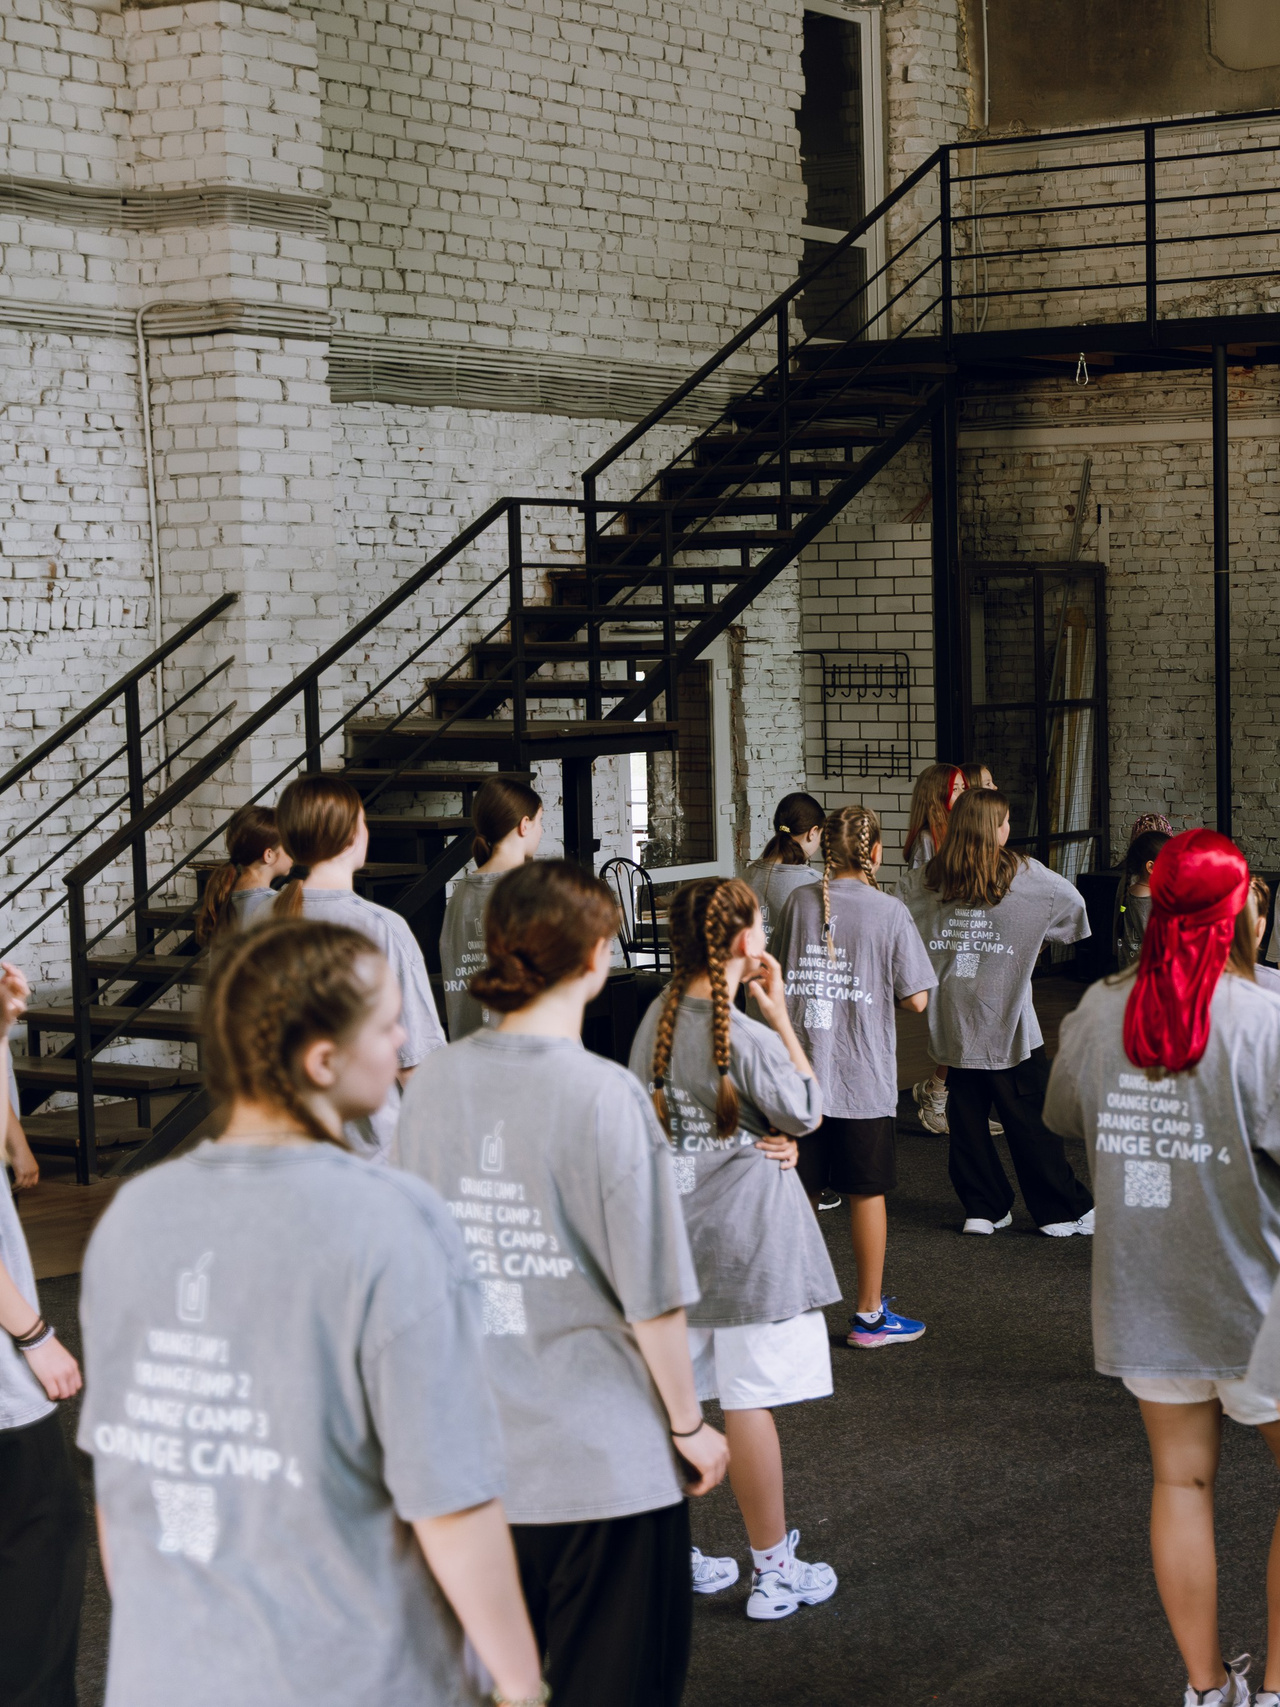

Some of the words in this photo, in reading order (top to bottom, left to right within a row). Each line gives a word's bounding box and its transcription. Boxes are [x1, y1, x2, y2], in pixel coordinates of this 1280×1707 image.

[941, 929, 970, 939] ORANGE
[971, 931, 994, 940] CAMP
[995, 932, 1001, 941] 3
[948, 919, 969, 929] ORANGE
[970, 920, 988, 929] CAMP
[988, 921, 993, 930] 2
[467, 941, 485, 950] ORAN
[806, 944, 828, 956] ORANGE
[929, 940, 970, 952] ORANGE
[973, 941, 1004, 954] CAMP
[1006, 945, 1014, 956] 4
[827, 959, 847, 971] CAMP
[847, 962, 853, 973] 2
[443, 979, 468, 992] ORA
[787, 970, 825, 981] ORANGE
[826, 972, 853, 985] CAMP
[853, 976, 860, 987] 3
[784, 983, 825, 996] RANGE
[826, 986, 864, 1002] CAMP
[865, 992, 873, 1005] 4
[1107, 1092, 1149, 1112] ORANGE
[1150, 1096, 1181, 1115] CAMP
[1181, 1101, 1189, 1117] 2
[681, 1119, 711, 1134] CAMP
[1151, 1118, 1192, 1137] CAMP
[1193, 1122, 1205, 1140] 3
[1095, 1132, 1151, 1157] ANGE
[1155, 1138, 1214, 1163] CAMP
[1217, 1146, 1232, 1166] 4
[496, 1205, 531, 1226] CAMP
[532, 1208, 543, 1227] 2
[464, 1226, 496, 1247] NGE
[498, 1229, 547, 1251] CAMP
[549, 1234, 560, 1253] 3
[503, 1252, 575, 1278] CAMP
[237, 1373, 252, 1398] 2
[188, 1405, 251, 1433] CAMP
[256, 1411, 268, 1439] 3
[95, 1424, 184, 1472] ORNGE
[285, 1458, 303, 1487] 4
